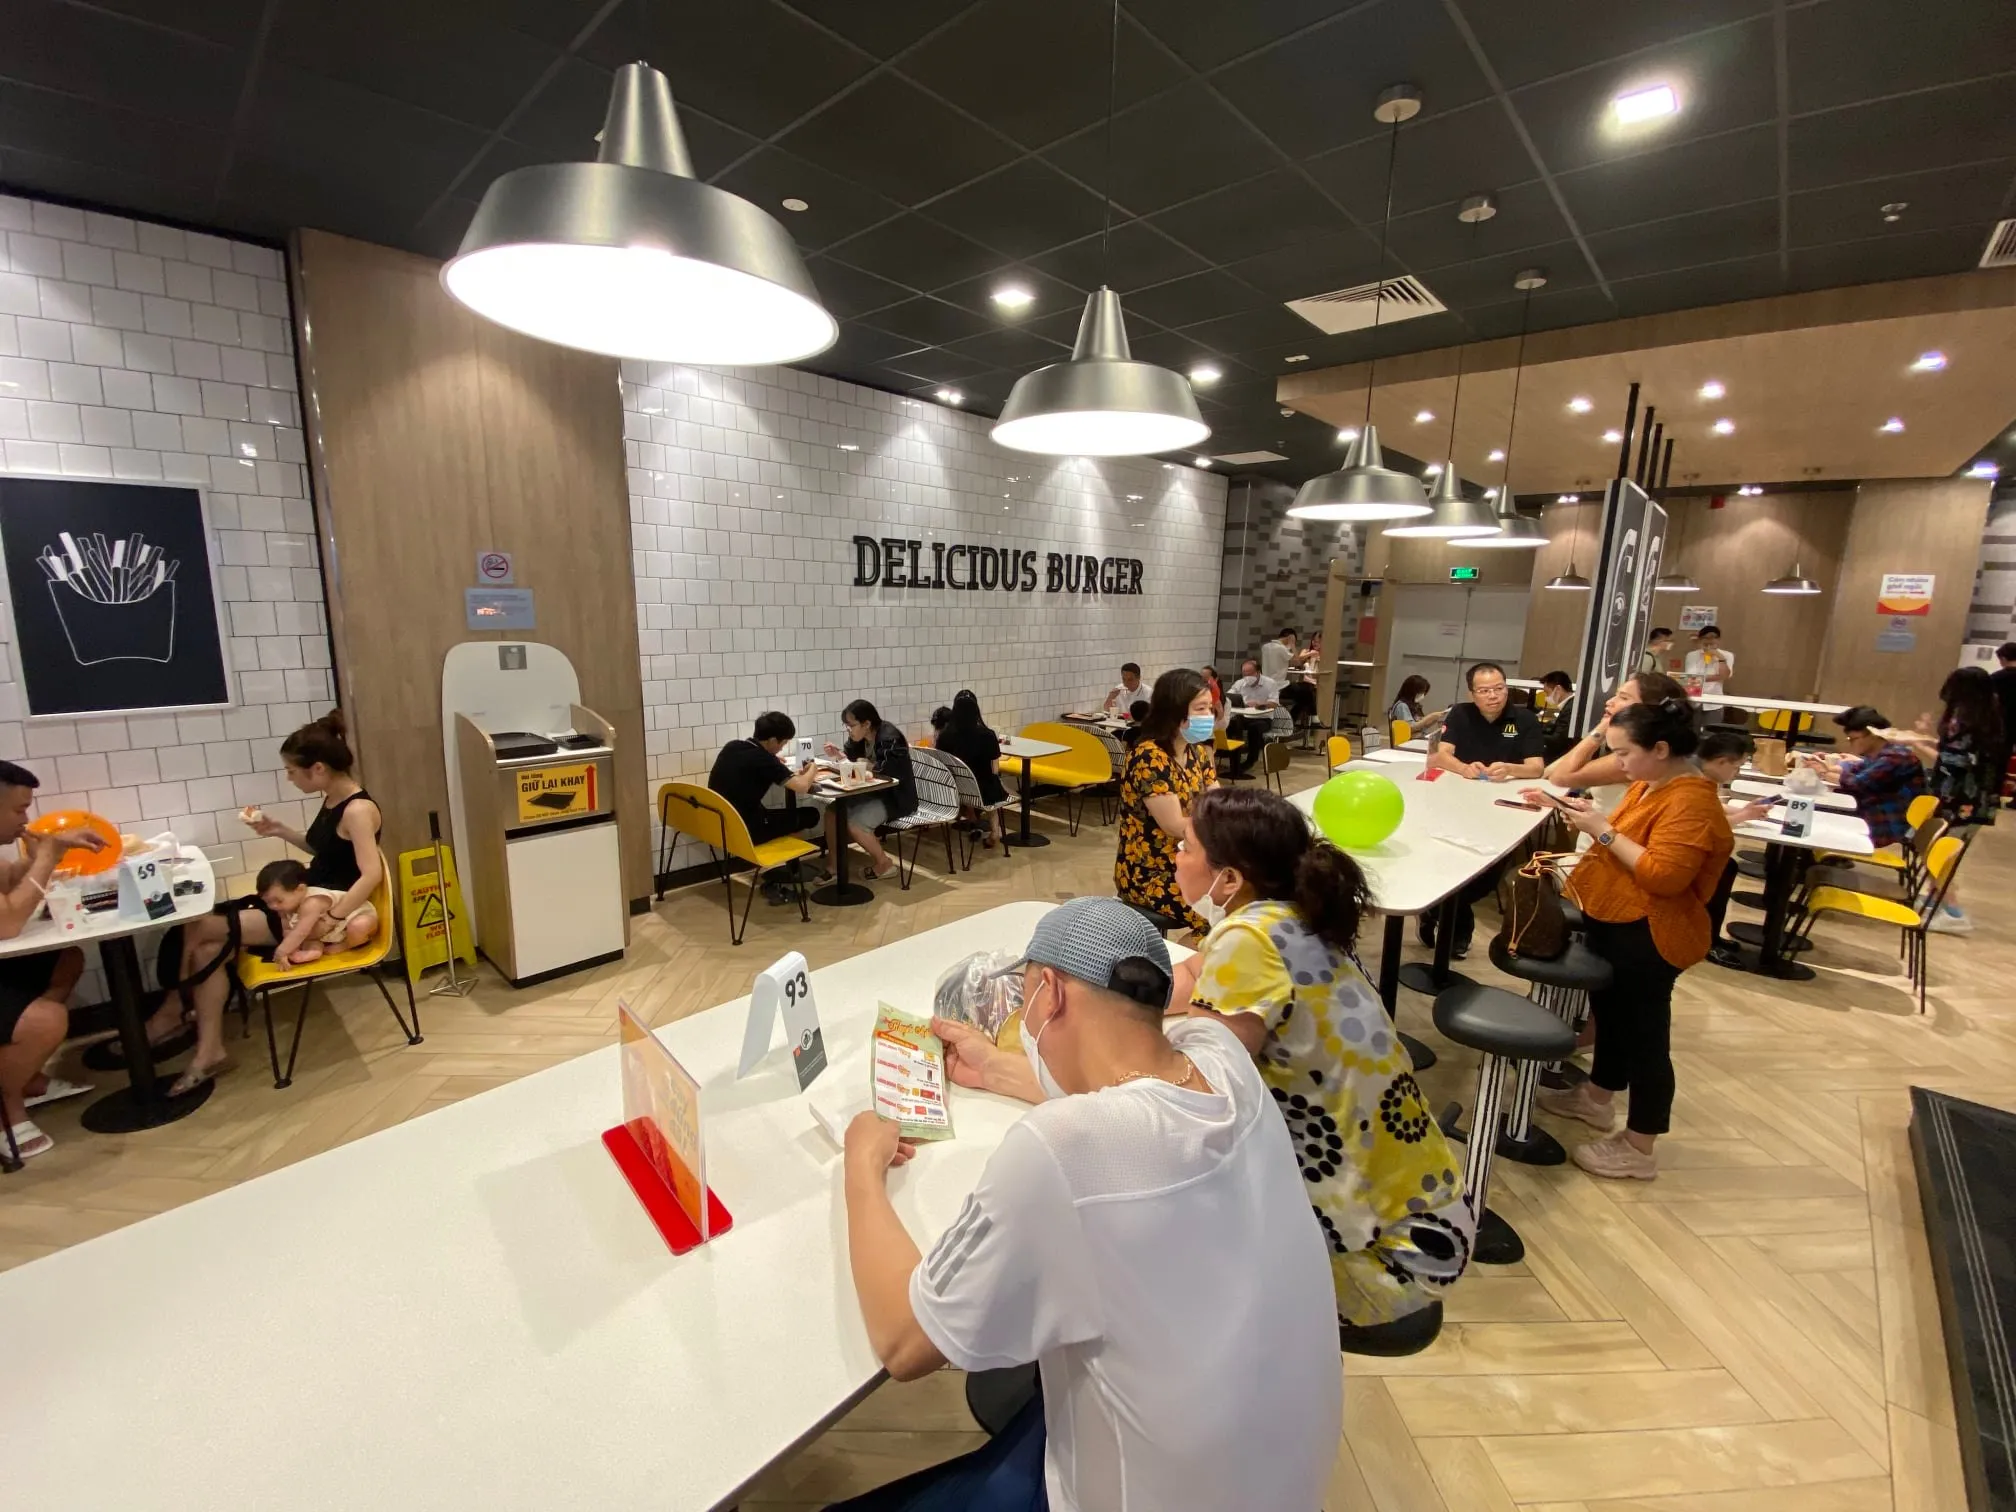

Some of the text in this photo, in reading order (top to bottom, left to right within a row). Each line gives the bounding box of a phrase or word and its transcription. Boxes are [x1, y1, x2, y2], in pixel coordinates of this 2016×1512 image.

[853, 535, 1144, 595] DELICIOUS BURGER
[802, 742, 812, 750] 70
[560, 775, 585, 787] KHAY
[1791, 801, 1808, 811] 89
[785, 971, 808, 1009] 93
